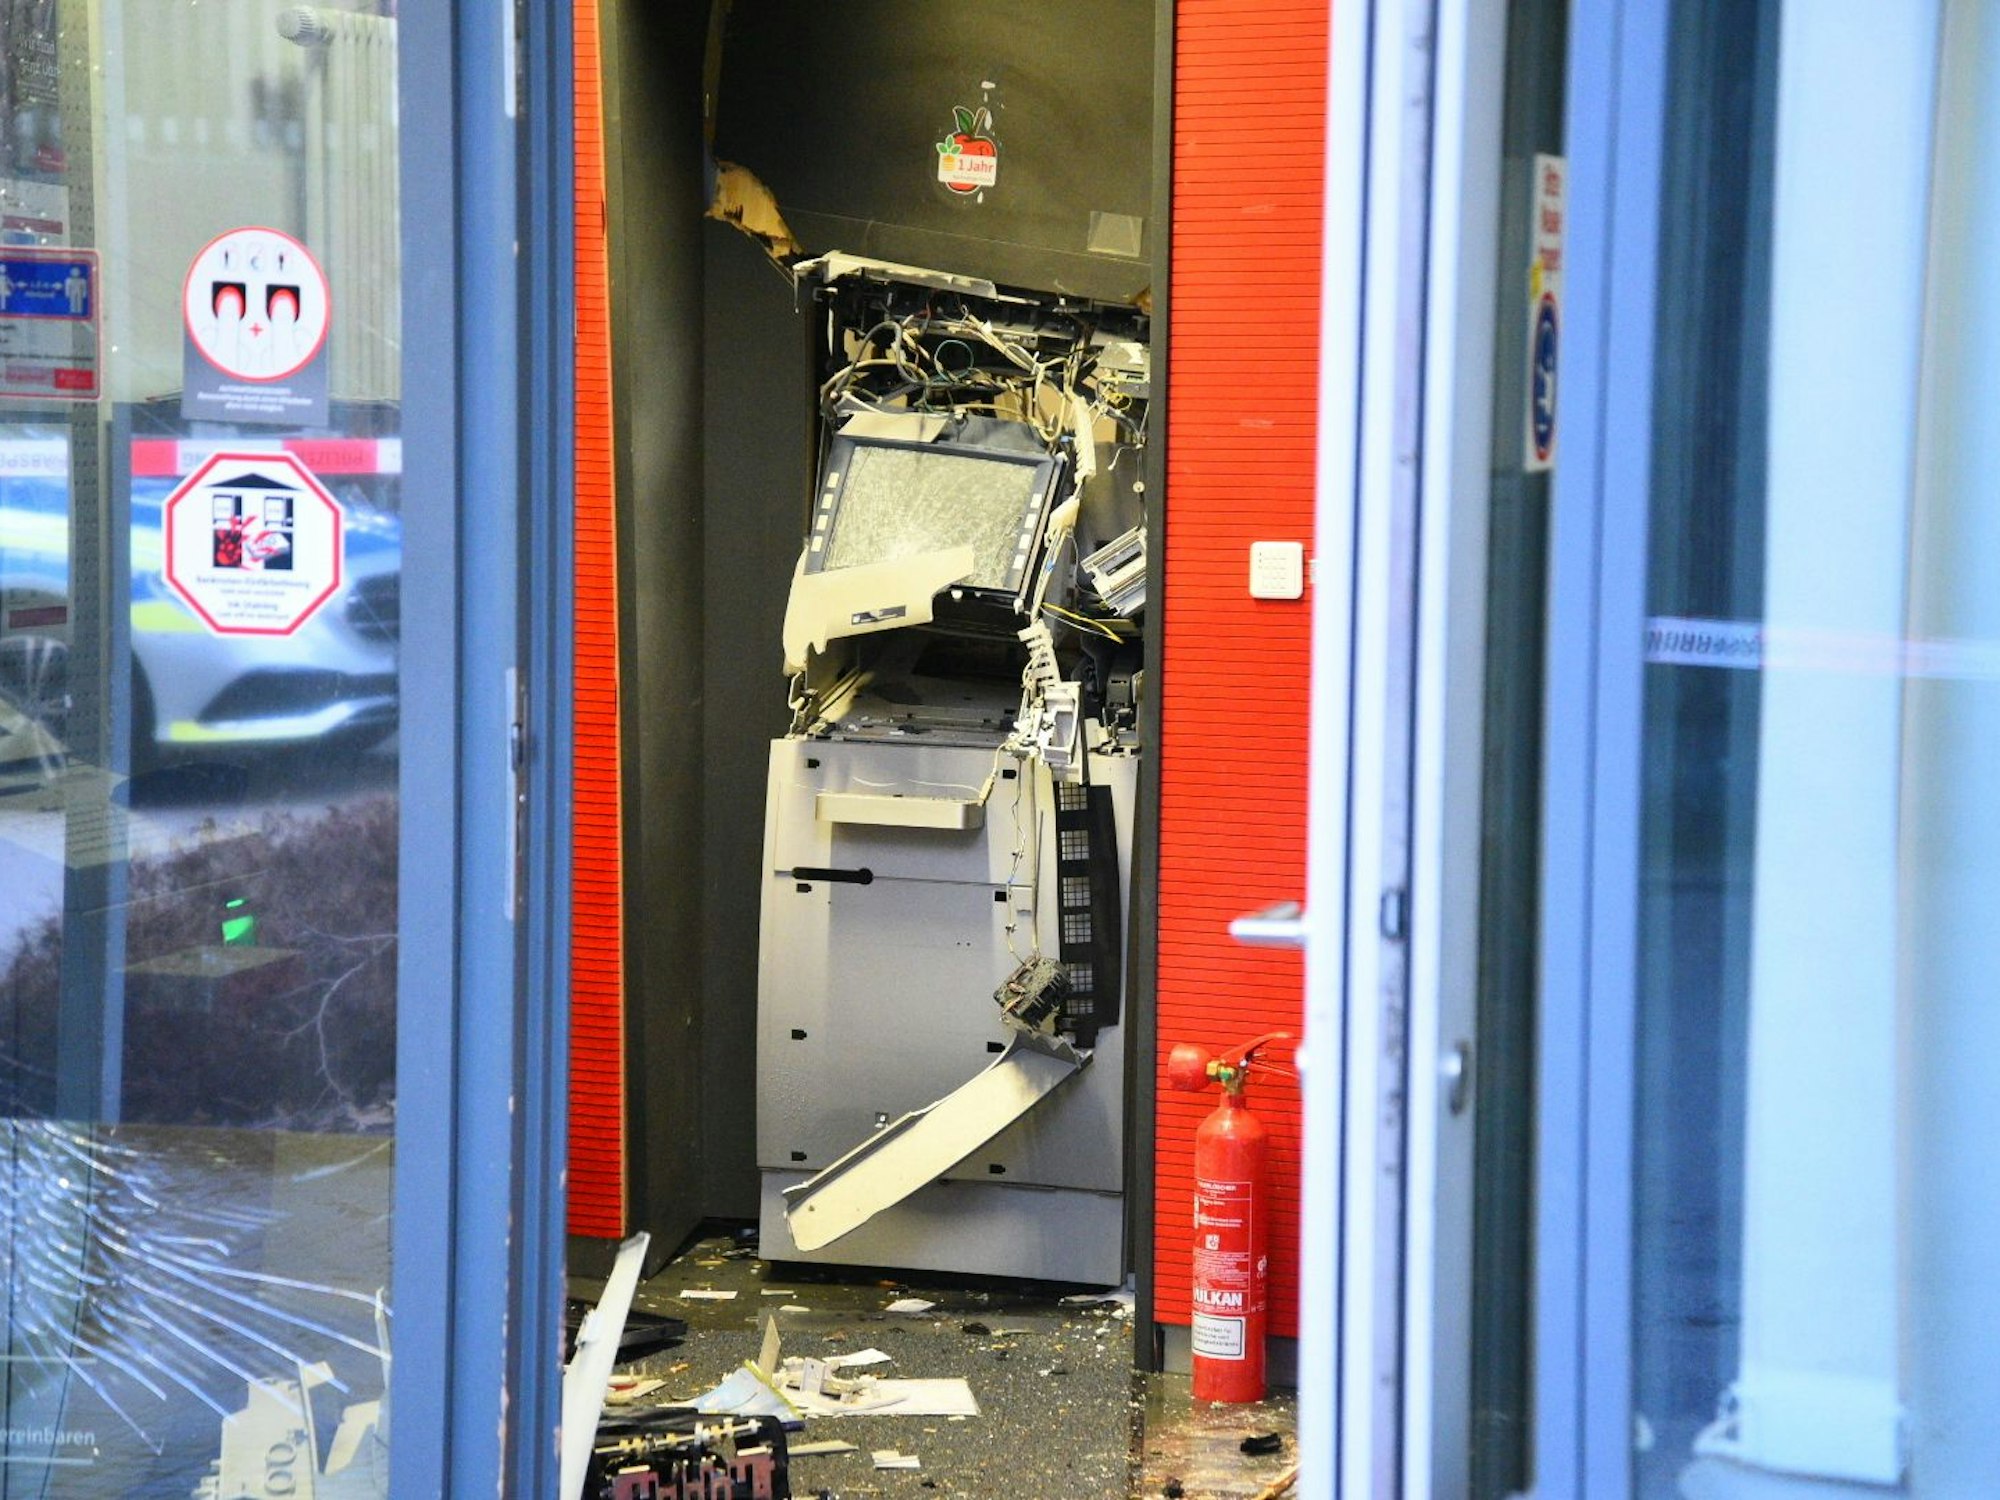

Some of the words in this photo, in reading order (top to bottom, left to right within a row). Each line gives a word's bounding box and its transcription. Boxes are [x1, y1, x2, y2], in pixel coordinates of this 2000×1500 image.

[958, 158, 965, 170] 1
[967, 158, 994, 173] Jahr
[1194, 1287, 1243, 1307] ULKAN
